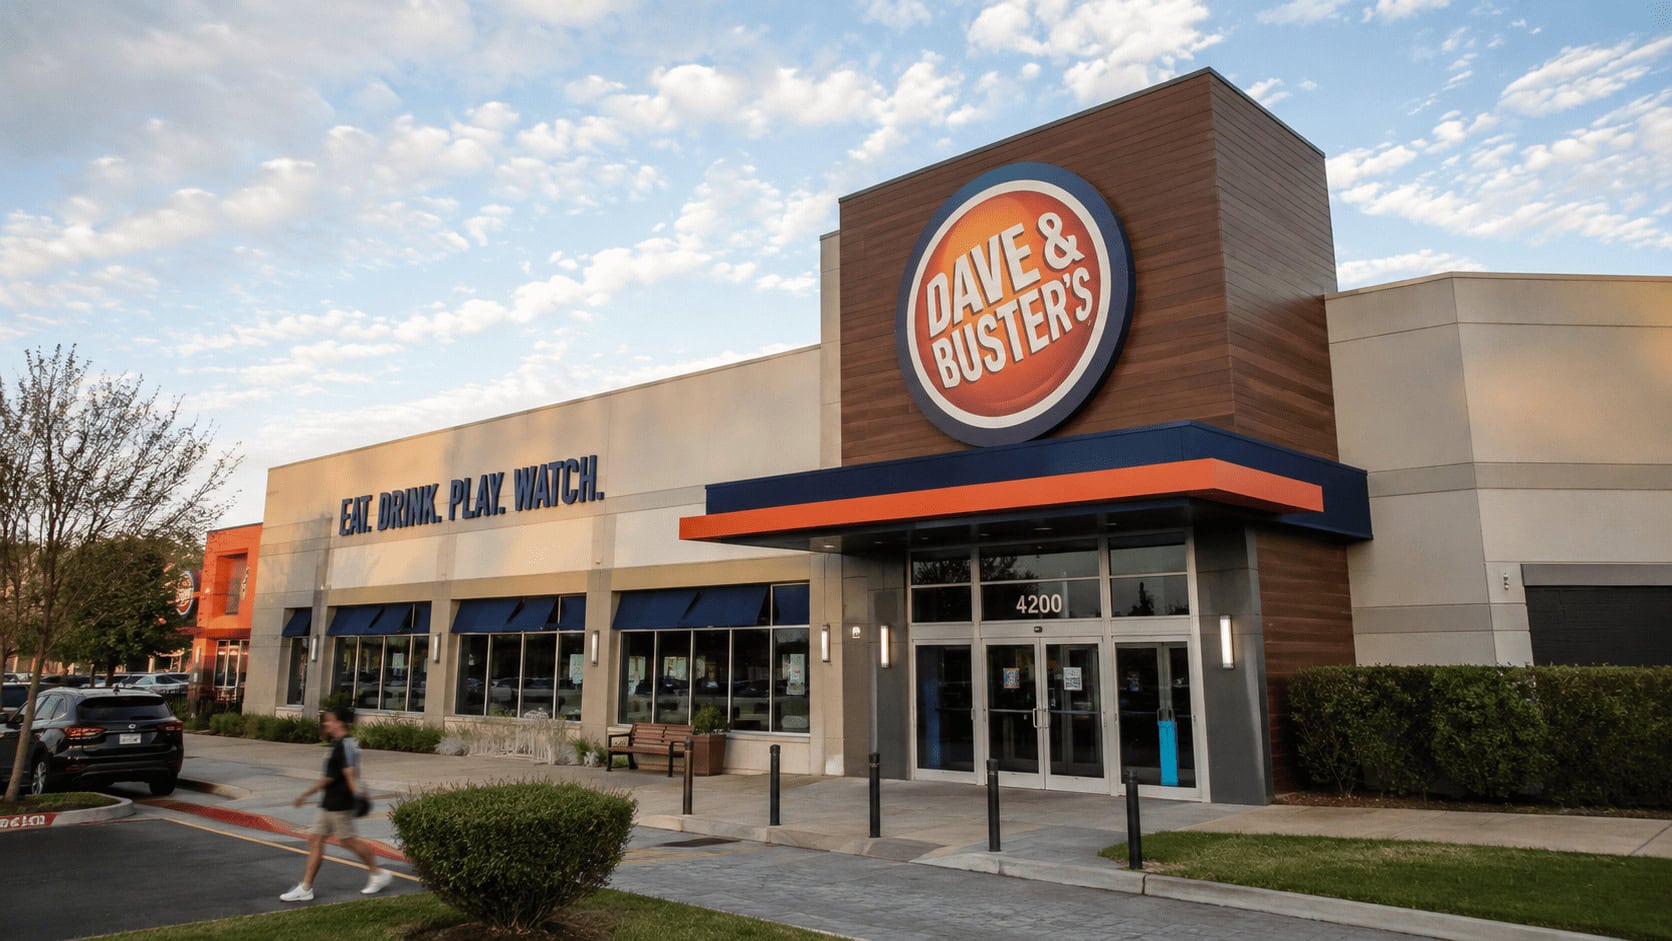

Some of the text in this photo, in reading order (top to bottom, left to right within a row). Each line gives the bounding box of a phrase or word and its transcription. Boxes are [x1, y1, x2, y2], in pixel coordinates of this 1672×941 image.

[927, 212, 1085, 338] DAVE &
[931, 267, 1094, 389] BUSTER'S
[339, 455, 605, 536] EAT. DRINK. PLAY. WATCH.
[1016, 594, 1062, 613] 4200
